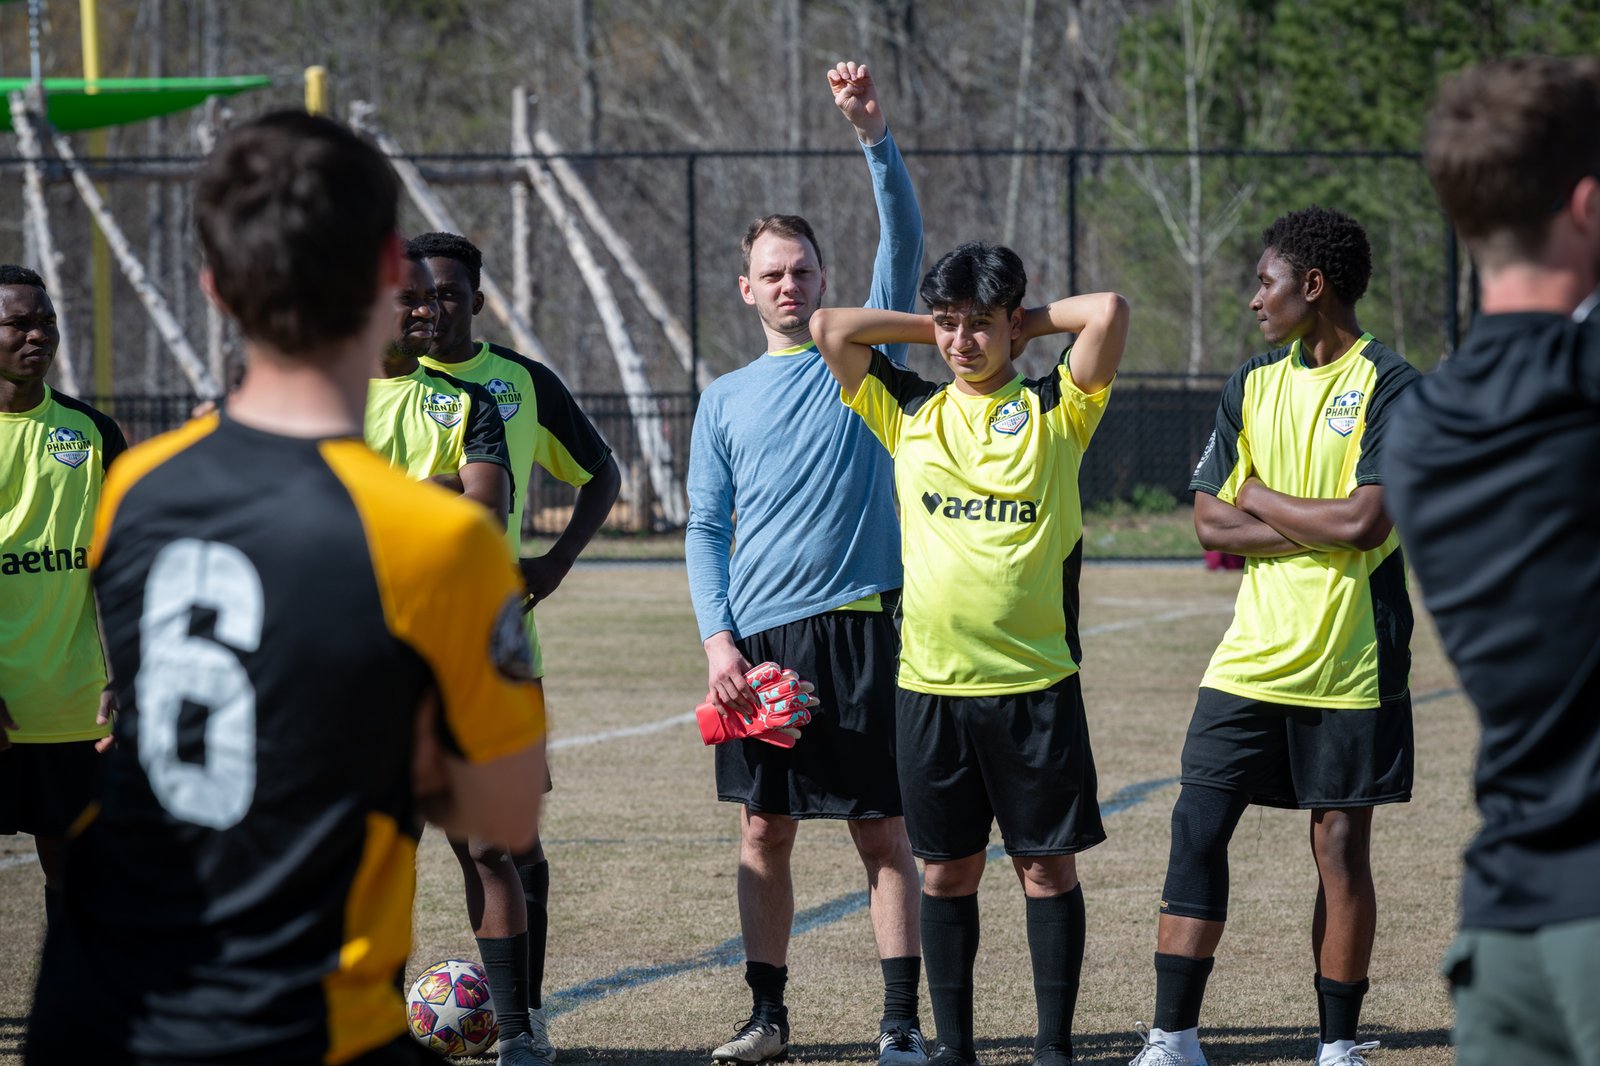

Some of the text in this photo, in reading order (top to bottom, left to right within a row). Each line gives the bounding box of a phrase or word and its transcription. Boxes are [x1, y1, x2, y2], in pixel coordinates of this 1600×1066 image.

[1325, 406, 1361, 417] PHANTO
[47, 440, 92, 453] PHANTOM
[943, 495, 1037, 523] aetna
[1, 545, 88, 575] aetna
[135, 537, 265, 832] 6
